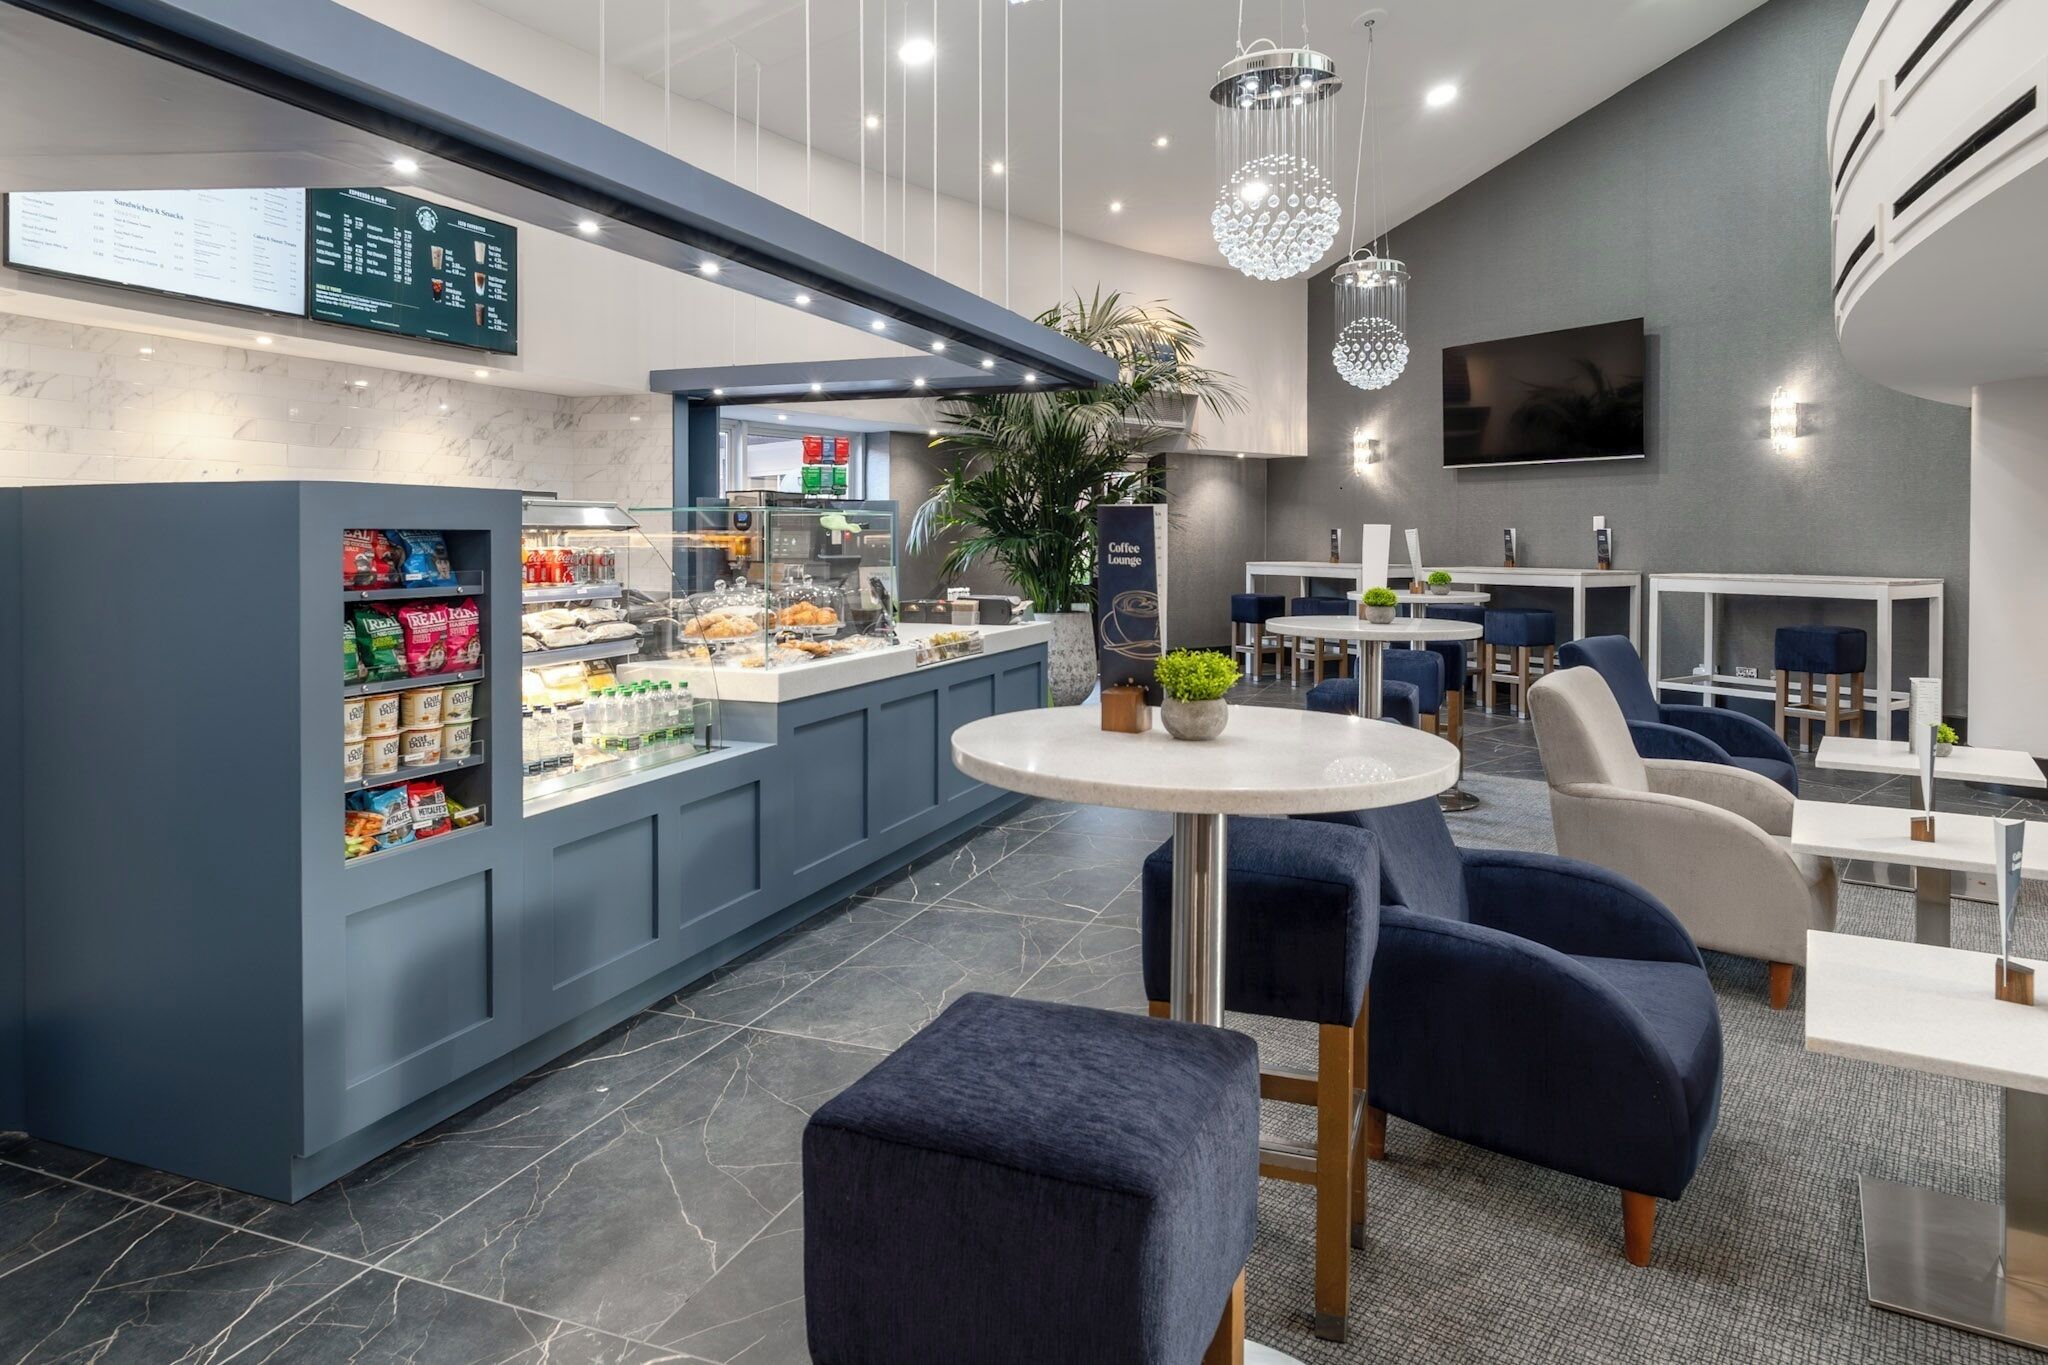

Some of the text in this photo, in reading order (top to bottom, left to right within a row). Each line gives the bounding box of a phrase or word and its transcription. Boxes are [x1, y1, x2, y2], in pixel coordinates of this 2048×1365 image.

[114, 198, 154, 214] Sandwiches
[161, 210, 184, 221] Snacks
[343, 530, 370, 541] EAL
[1109, 541, 1140, 553] Coffee
[1108, 553, 1142, 568] Lounge
[411, 611, 445, 626] REAL
[410, 734, 427, 743] oat
[418, 804, 447, 817] METCALFE'S
